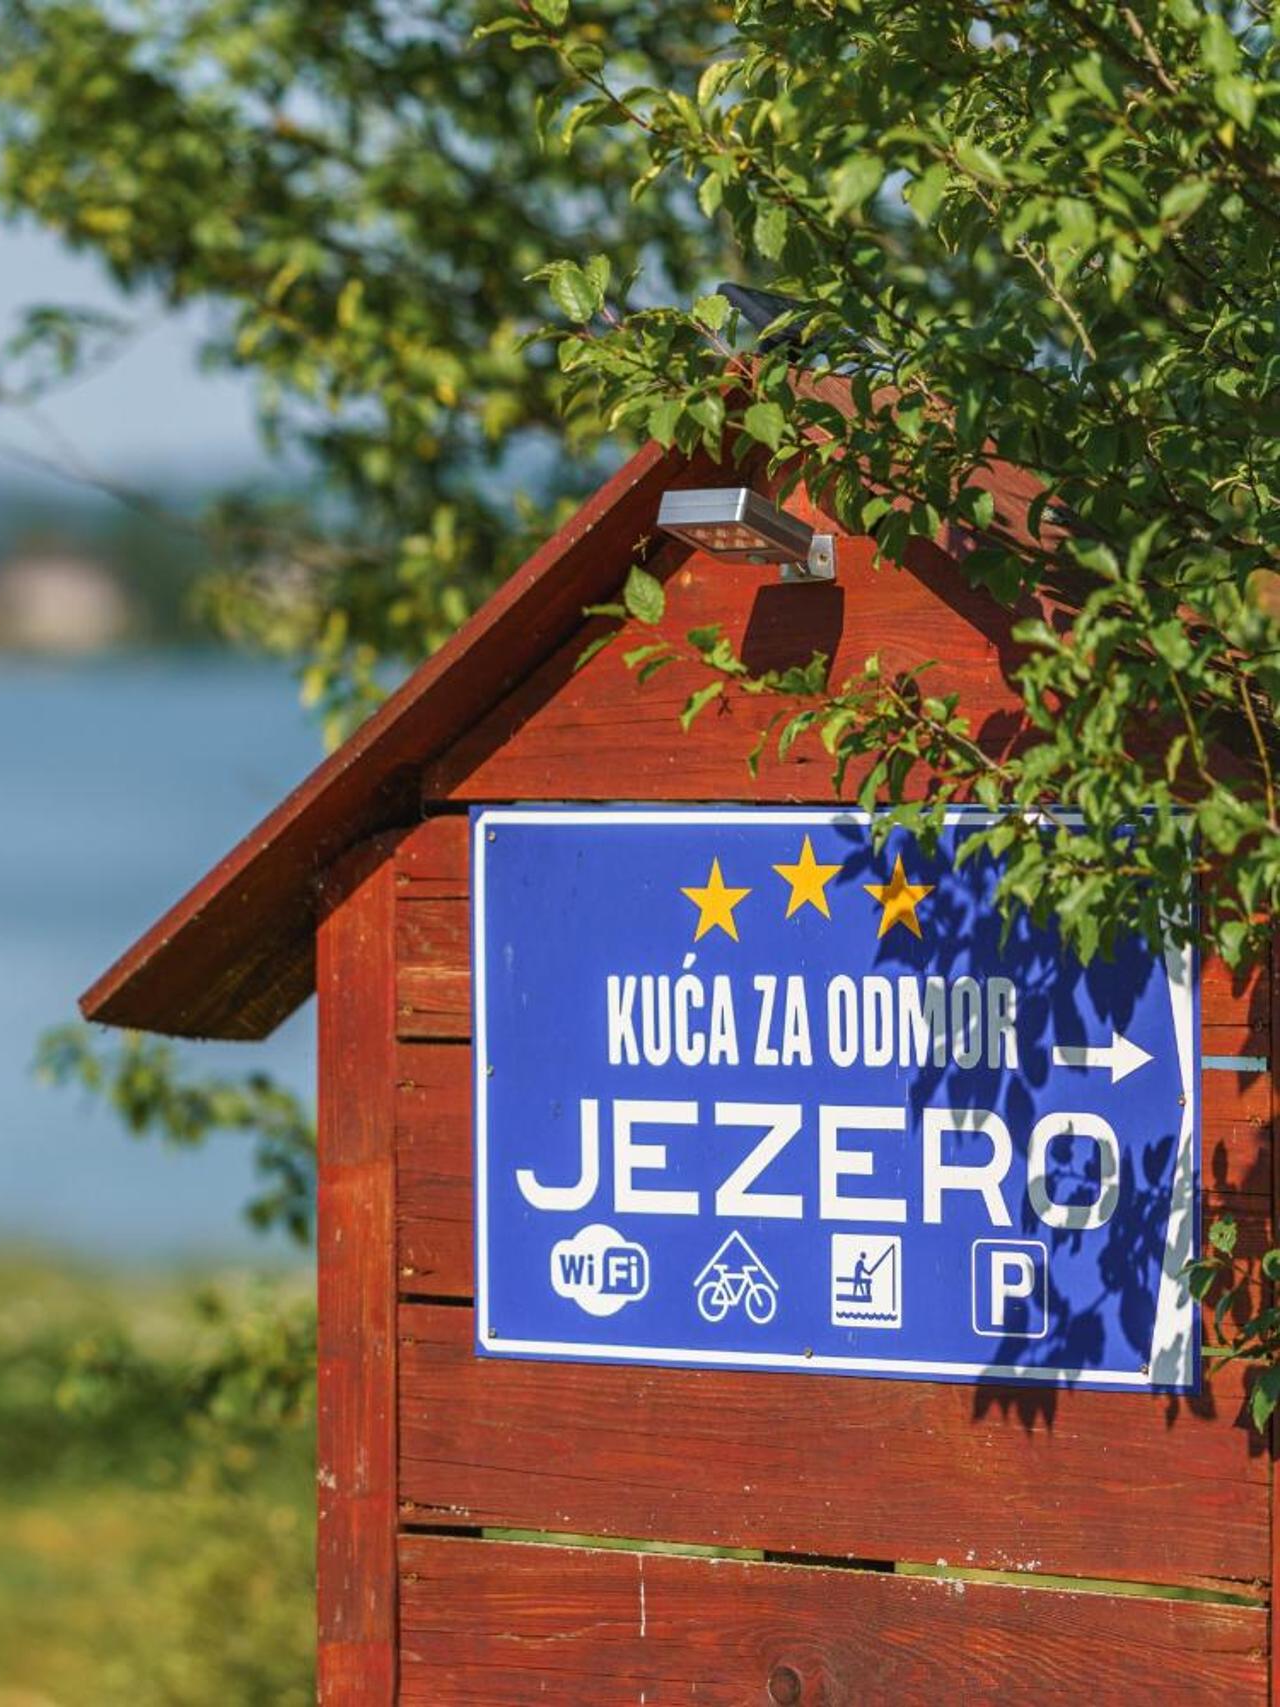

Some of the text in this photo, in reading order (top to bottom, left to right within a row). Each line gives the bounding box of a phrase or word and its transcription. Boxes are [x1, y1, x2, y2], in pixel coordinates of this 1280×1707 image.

[606, 952, 1019, 1070] KUĆA ZA ODMOR
[516, 1098, 1121, 1230] JEZERO
[990, 1250, 1035, 1327] P
